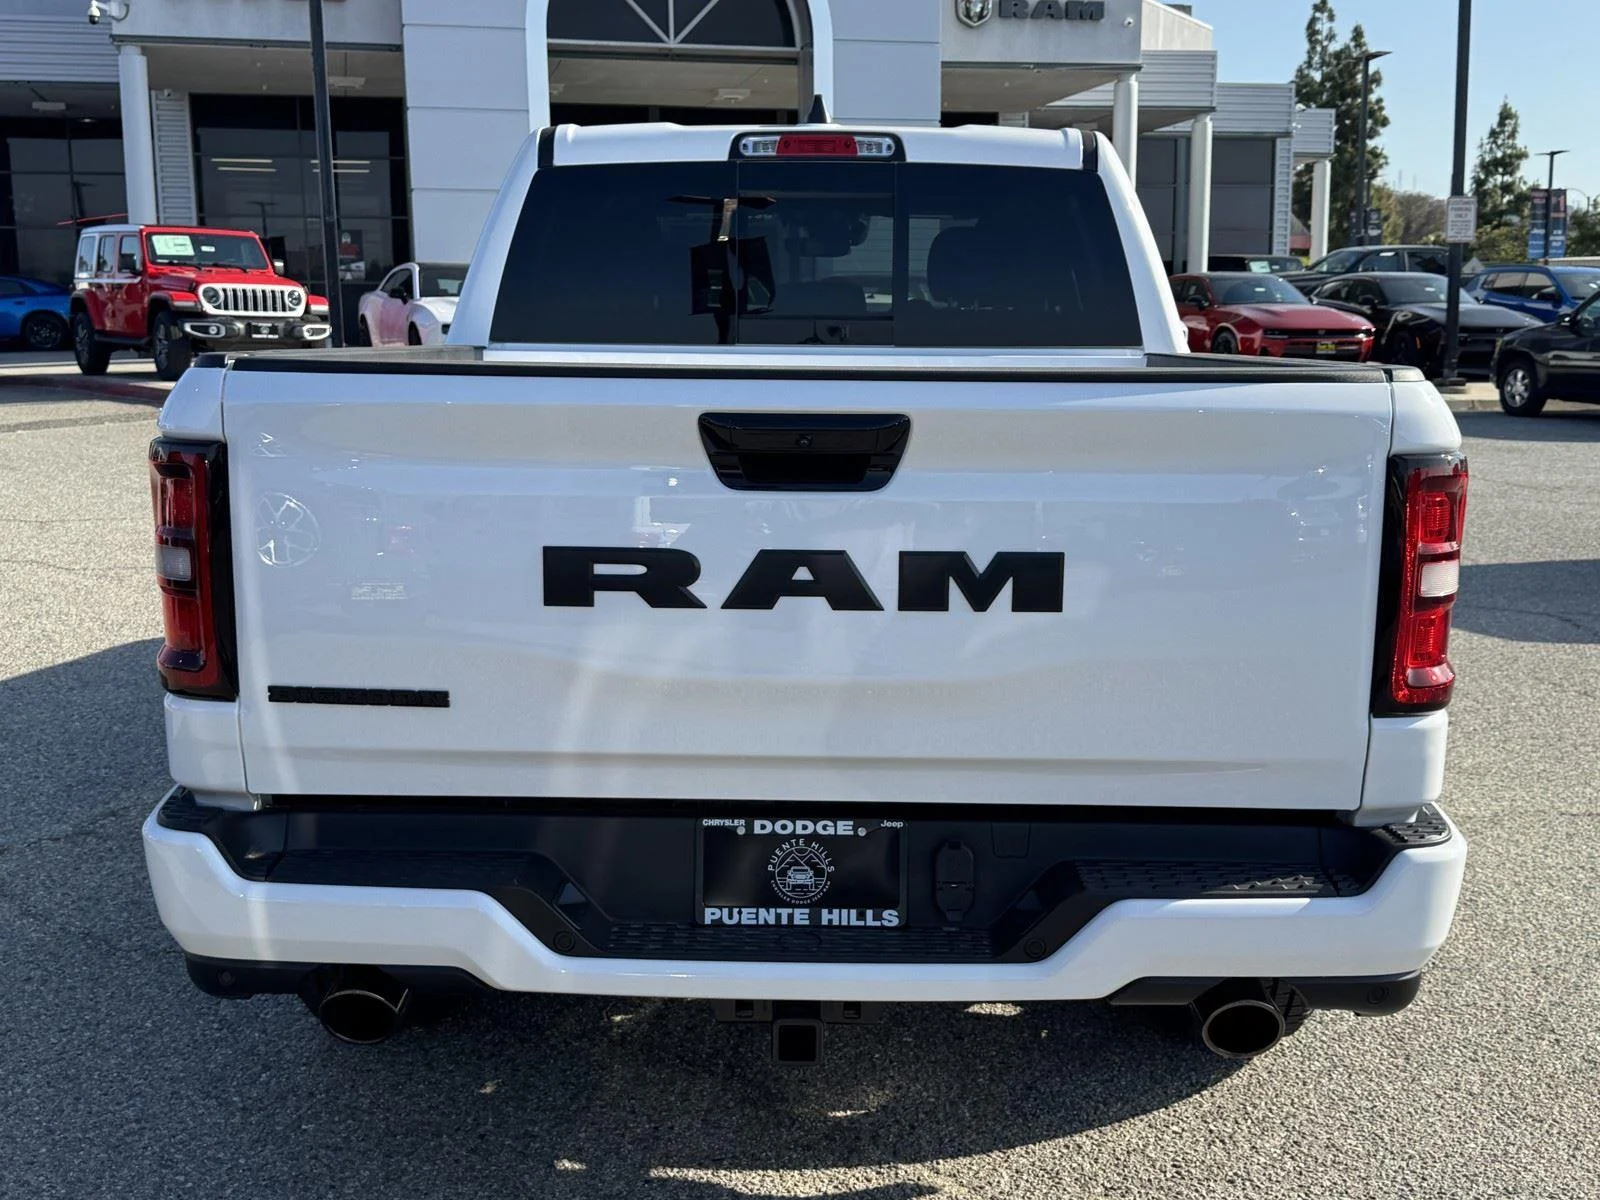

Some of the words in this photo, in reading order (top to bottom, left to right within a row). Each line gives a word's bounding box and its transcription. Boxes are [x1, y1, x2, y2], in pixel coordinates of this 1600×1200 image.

[999, 0, 1103, 20] RAM
[543, 546, 1064, 612] RAM
[753, 820, 854, 835] DODGE
[880, 820, 904, 828] Jeep
[768, 839, 805, 871] PUENTE
[811, 842, 835, 872] HILLS
[704, 907, 810, 925] PUENTE
[821, 909, 900, 926] HILLS
